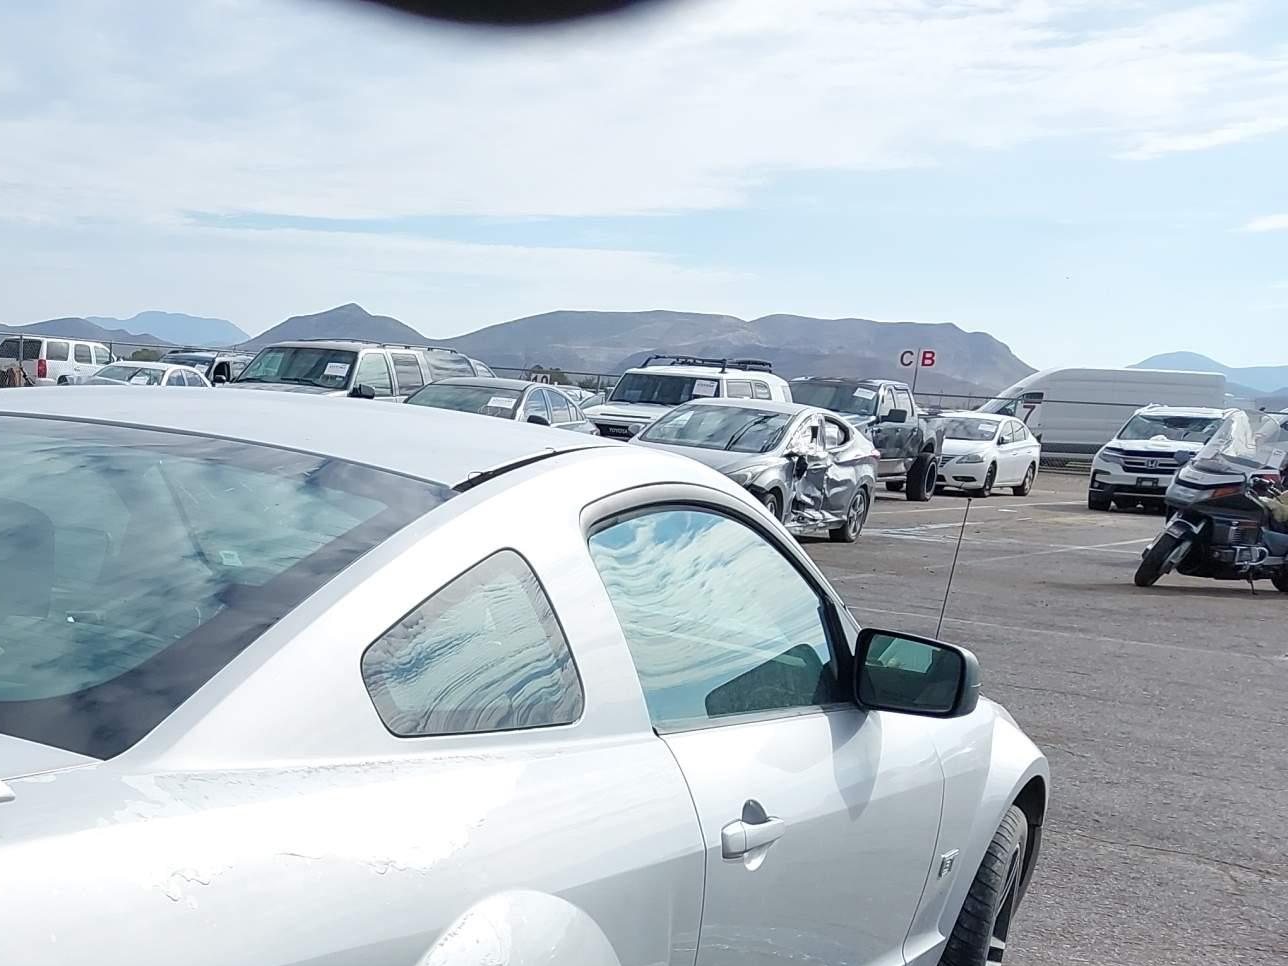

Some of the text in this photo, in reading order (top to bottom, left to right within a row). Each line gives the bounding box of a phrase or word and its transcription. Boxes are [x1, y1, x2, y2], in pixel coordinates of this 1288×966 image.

[900, 350, 914, 367] C
[921, 350, 935, 367] B
[1022, 404, 1036, 425] 7
